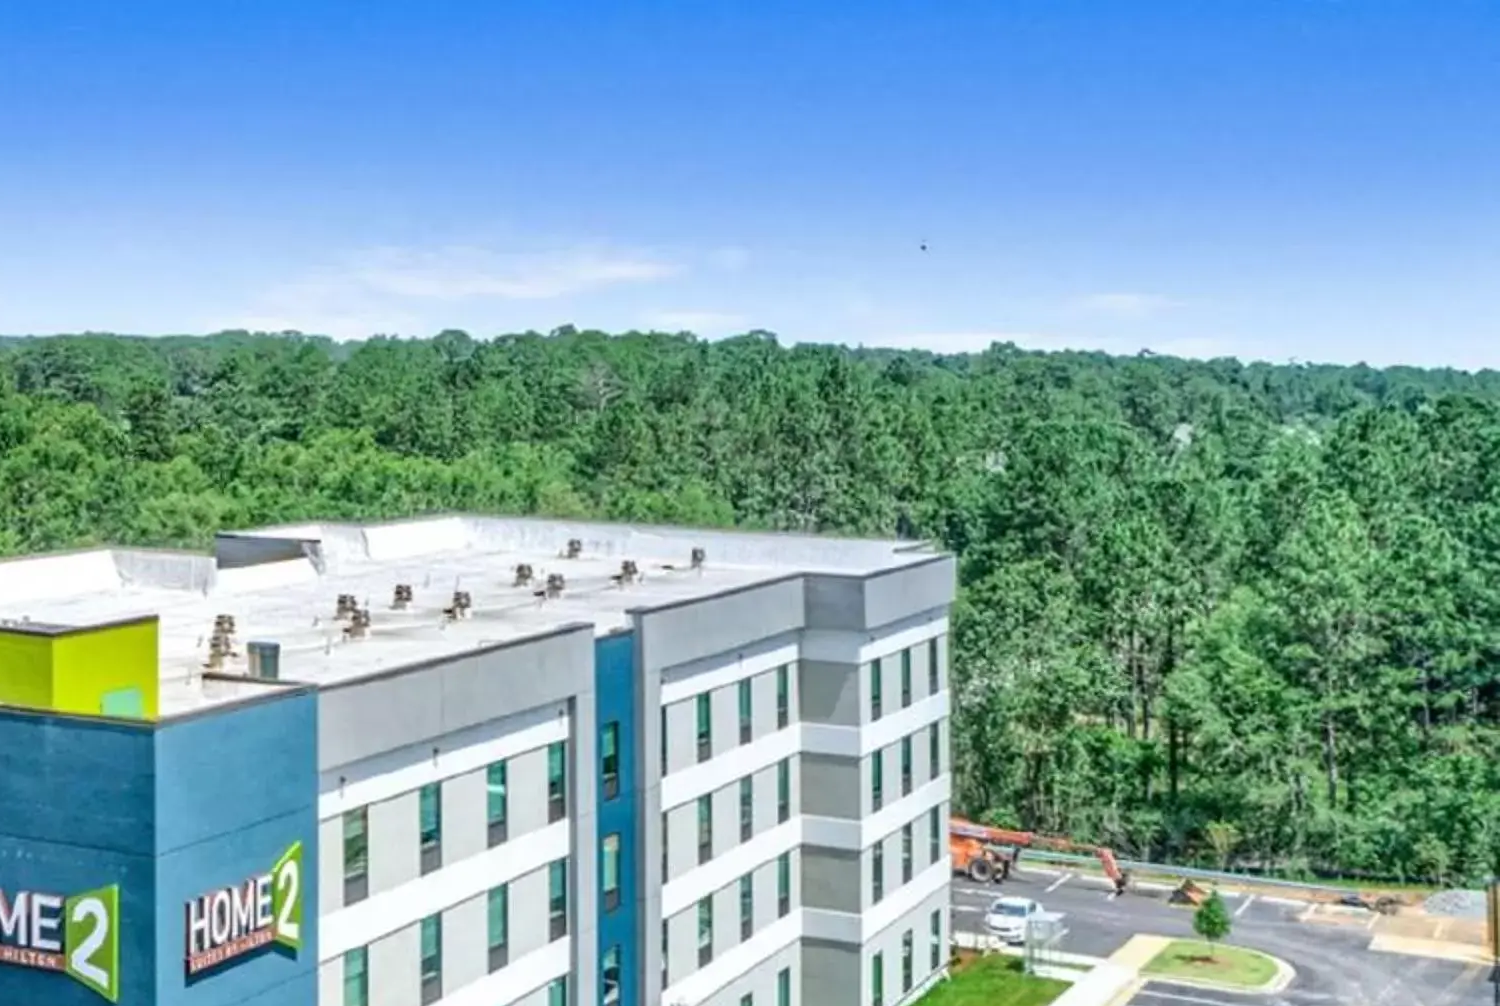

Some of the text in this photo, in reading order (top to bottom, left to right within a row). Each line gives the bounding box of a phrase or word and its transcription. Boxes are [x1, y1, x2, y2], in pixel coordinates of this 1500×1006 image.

[71, 897, 109, 988] 2
[190, 860, 299, 954] HOME 2
[3, 948, 57, 967] HILTON
